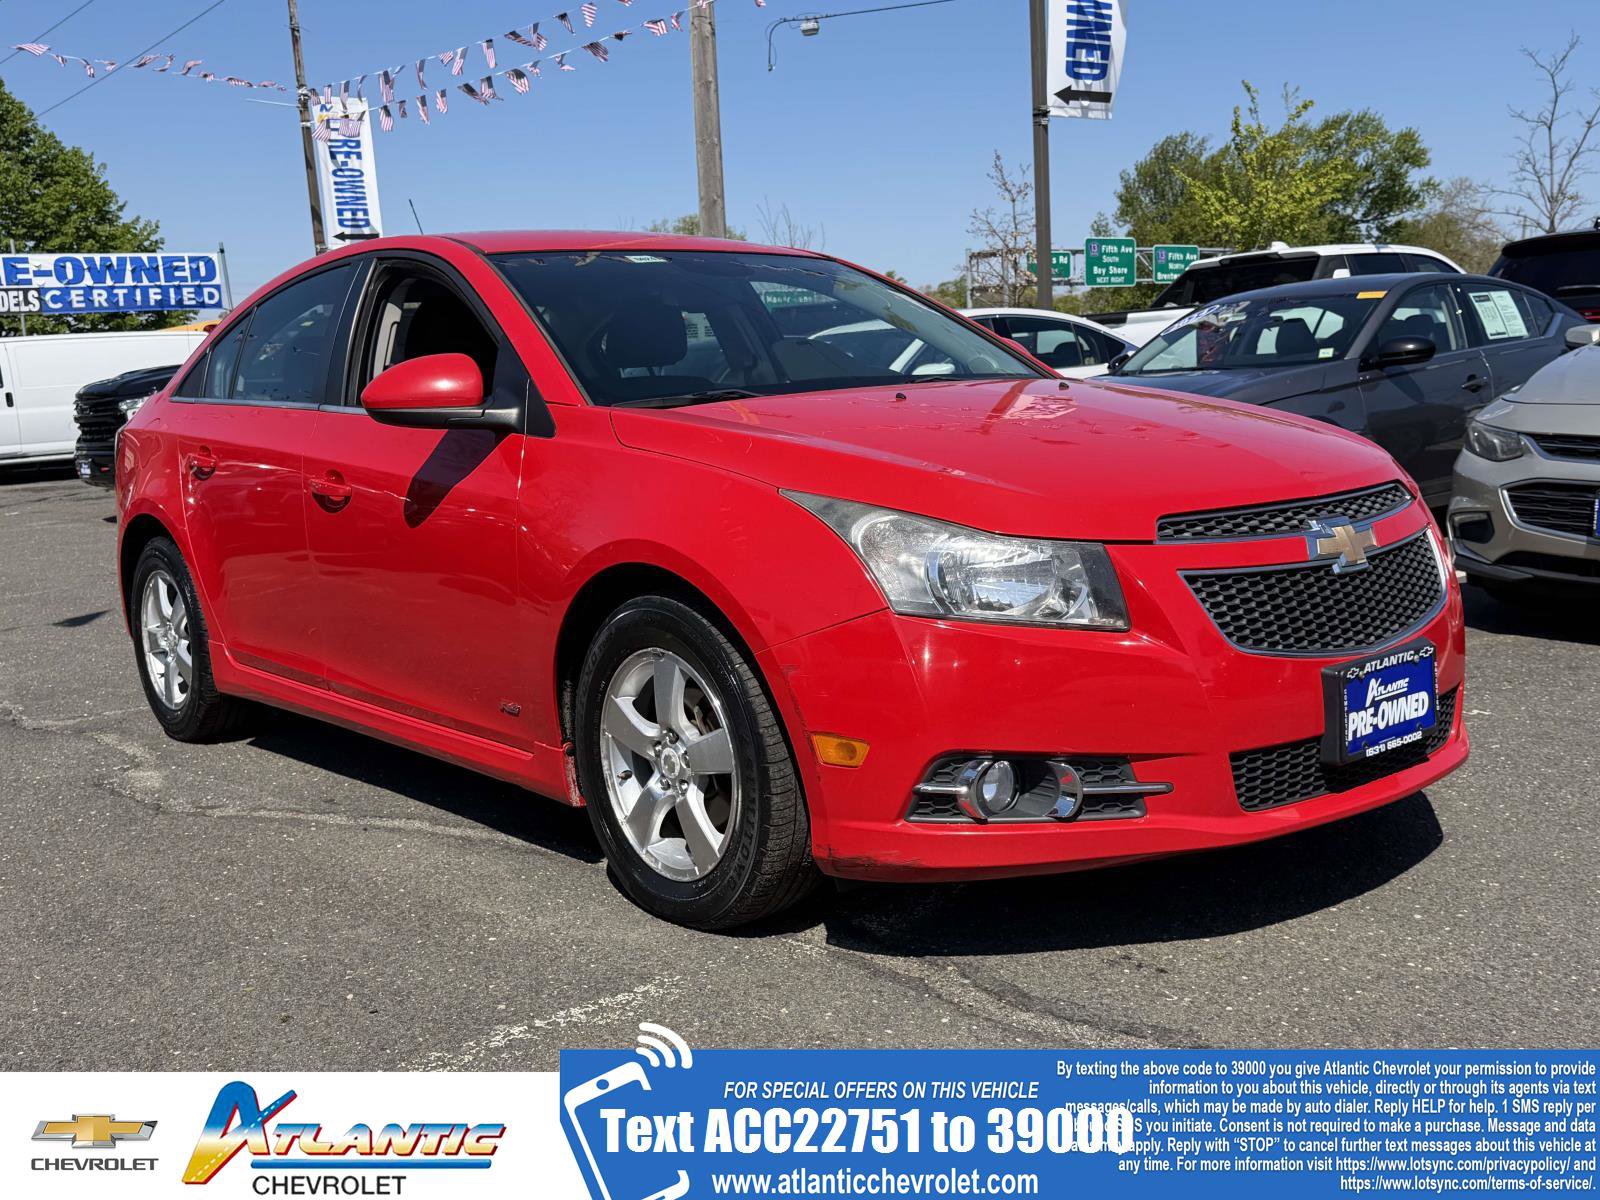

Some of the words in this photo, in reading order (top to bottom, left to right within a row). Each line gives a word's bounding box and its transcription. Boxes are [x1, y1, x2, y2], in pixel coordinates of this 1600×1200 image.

[327, 118, 371, 229] RE-OWNED
[1101, 245, 1118, 253] Fifth
[1120, 245, 1133, 253] Ave
[1168, 252, 1184, 261] Fifth
[1185, 253, 1198, 261] Ave
[0, 256, 217, 286] E-OWNED
[1093, 266, 1106, 276] Bay
[1108, 266, 1128, 275] Shore
[45, 287, 219, 309] CERTIFIED
[1363, 650, 1415, 674] ATLANTIC
[1365, 677, 1410, 708] ATLANTIC
[1348, 690, 1429, 742] PRE-OWNED
